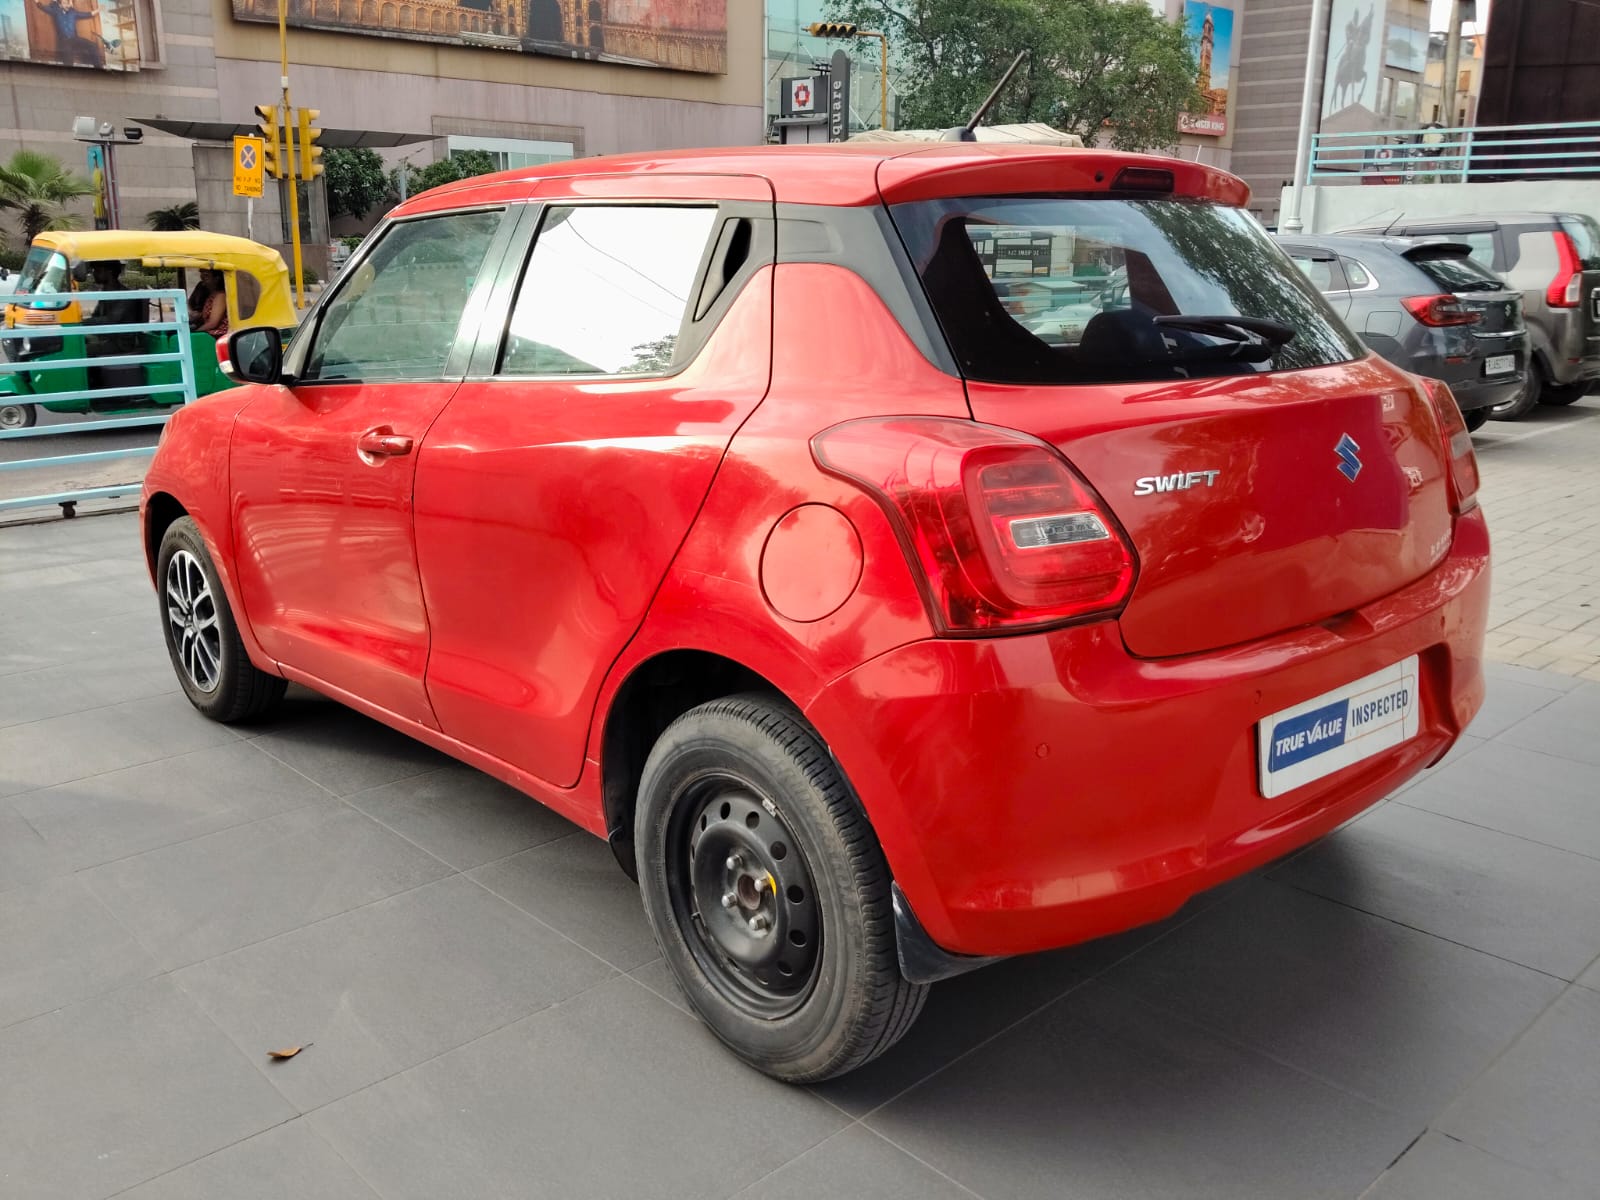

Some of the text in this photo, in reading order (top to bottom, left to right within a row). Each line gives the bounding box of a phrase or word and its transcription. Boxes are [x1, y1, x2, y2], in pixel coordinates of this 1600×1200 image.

[1133, 470, 1220, 496] SWIFT
[1275, 689, 1409, 757] TRUE VALUE INSPECTED
